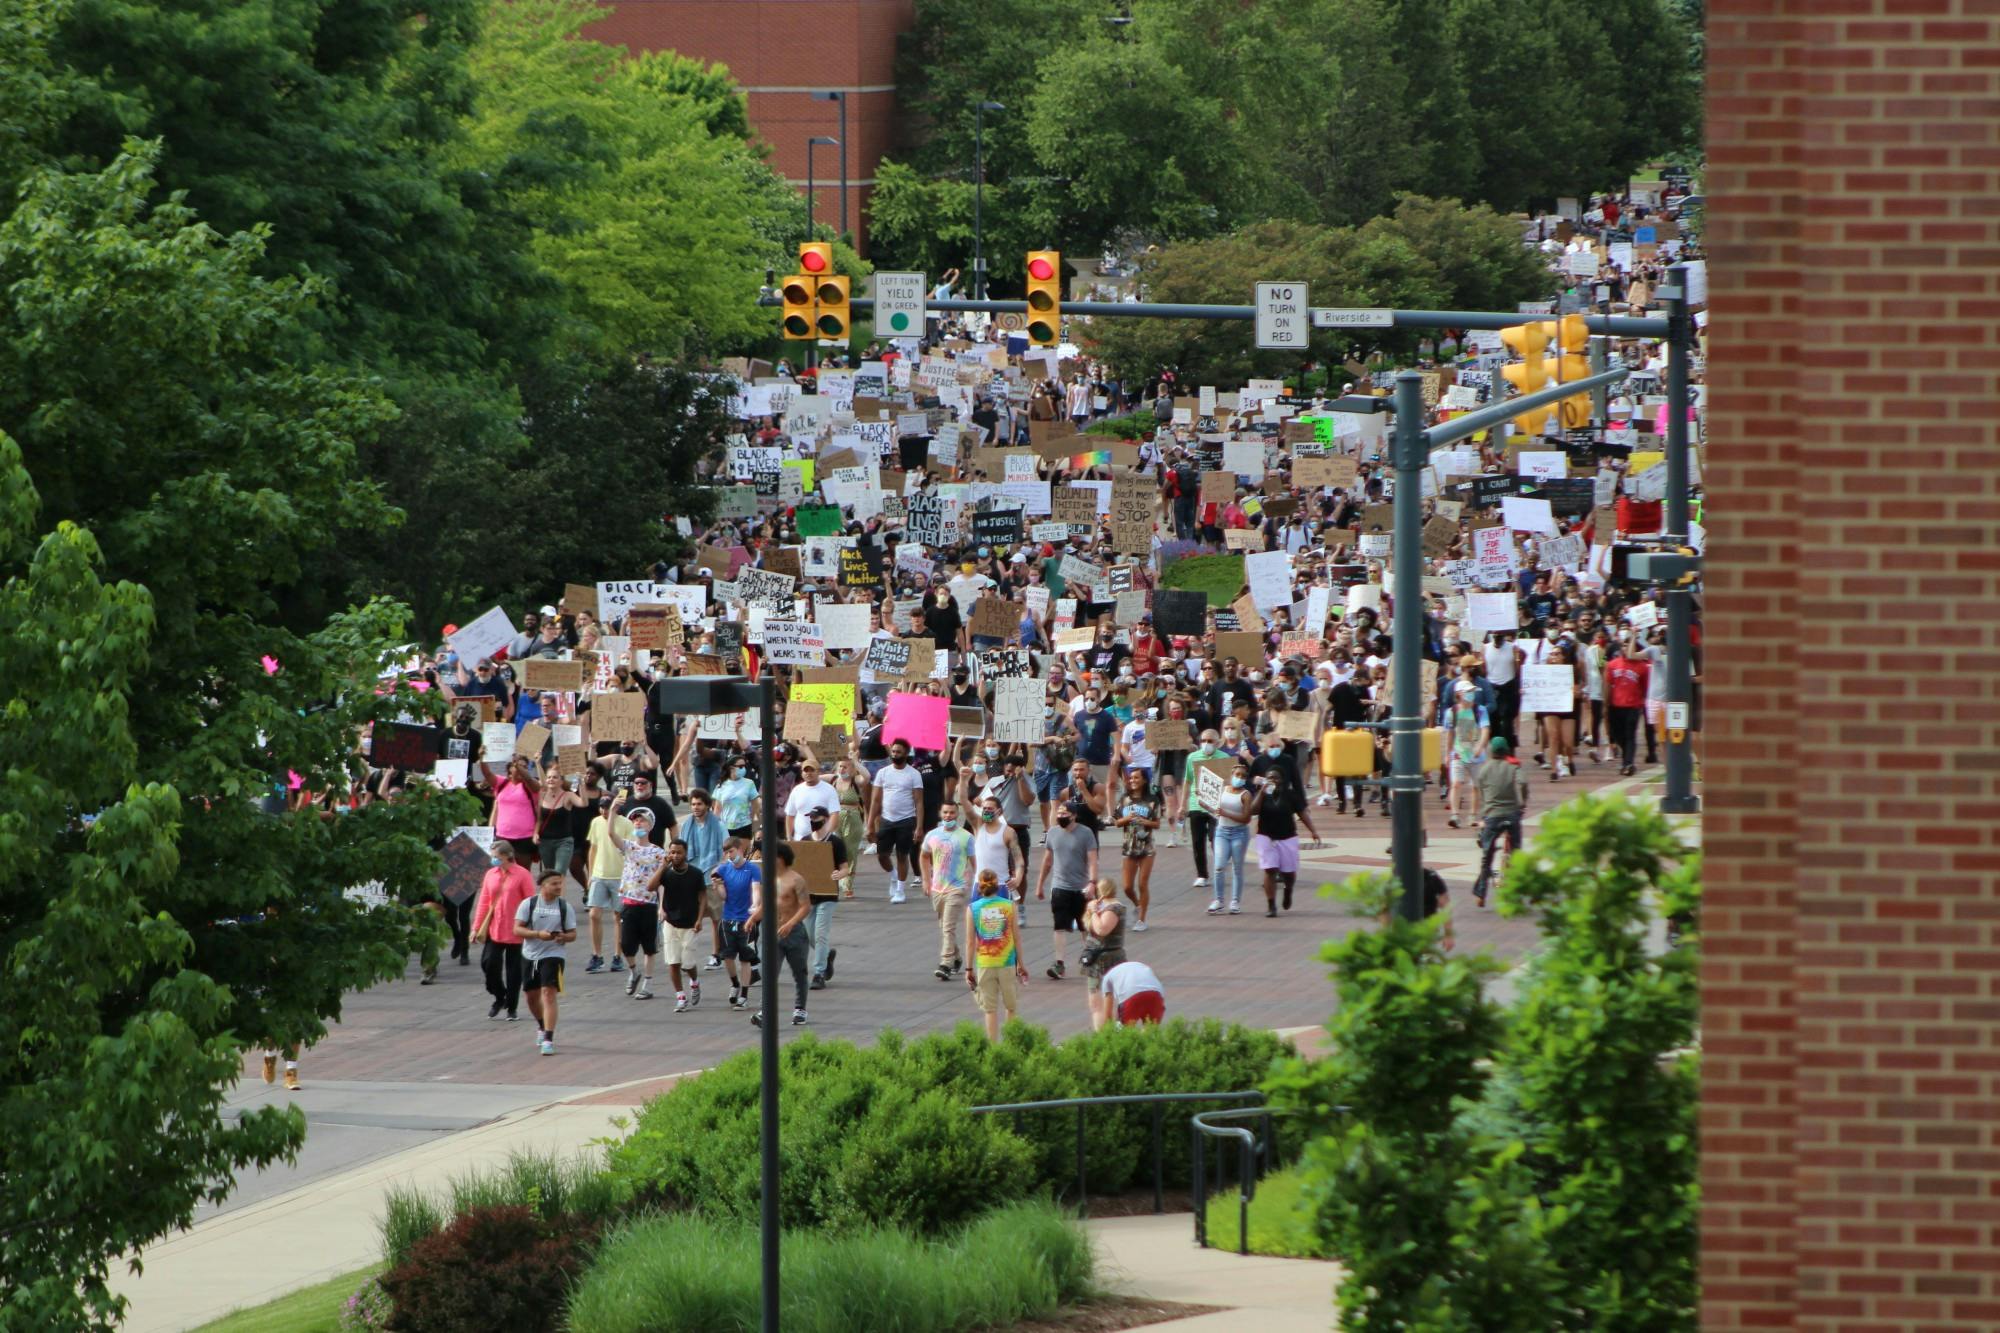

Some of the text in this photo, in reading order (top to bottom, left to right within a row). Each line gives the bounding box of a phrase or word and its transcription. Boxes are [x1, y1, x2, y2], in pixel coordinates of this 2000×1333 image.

[881, 278, 920, 286] LEFT TURN
[887, 289, 914, 299] YIELD
[1271, 289, 1293, 300] NO
[881, 302, 920, 310] ON GREEN
[1269, 304, 1296, 314] TURN
[1275, 318, 1290, 328] ON
[1325, 312, 1371, 323] Riverside
[1272, 332, 1293, 342] RED
[924, 366, 956, 378] JUSTICE
[930, 377, 954, 387] PEACE
[737, 449, 769, 460] BLACK
[749, 459, 780, 469] LIVES
[755, 473, 778, 484] ARE
[757, 484, 774, 494] WE
[1136, 491, 1154, 499] men
[908, 495, 943, 512] BLACK
[1120, 501, 1146, 510] has to
[1074, 510, 1097, 521] WIN
[1117, 509, 1152, 522] STOP
[908, 512, 941, 531] LIVES
[989, 516, 1017, 528] JUSTICE
[1067, 524, 1085, 534] BLM
[1116, 523, 1152, 535] BLACK
[1116, 534, 1152, 544] LIVES
[1486, 541, 1499, 549] FOR
[841, 549, 863, 560] Black
[1483, 549, 1499, 557] THE
[843, 560, 869, 572] Lives
[1455, 560, 1475, 570] END
[1447, 568, 1468, 576] WHITE
[847, 573, 880, 585] Matter
[1452, 575, 1480, 586] SILENC
[814, 593, 834, 605] Black
[765, 624, 812, 636] WHO DO YOU
[766, 637, 788, 645] WHEN
[789, 637, 801, 646] THE
[874, 640, 910, 656] White
[773, 650, 796, 659] WEARS
[798, 650, 813, 660] THE
[870, 647, 907, 664] Silence
[997, 678, 1046, 696] BLACK
[595, 695, 631, 712] END
[996, 695, 1044, 716] LIVES
[994, 718, 1045, 739] MATTER
